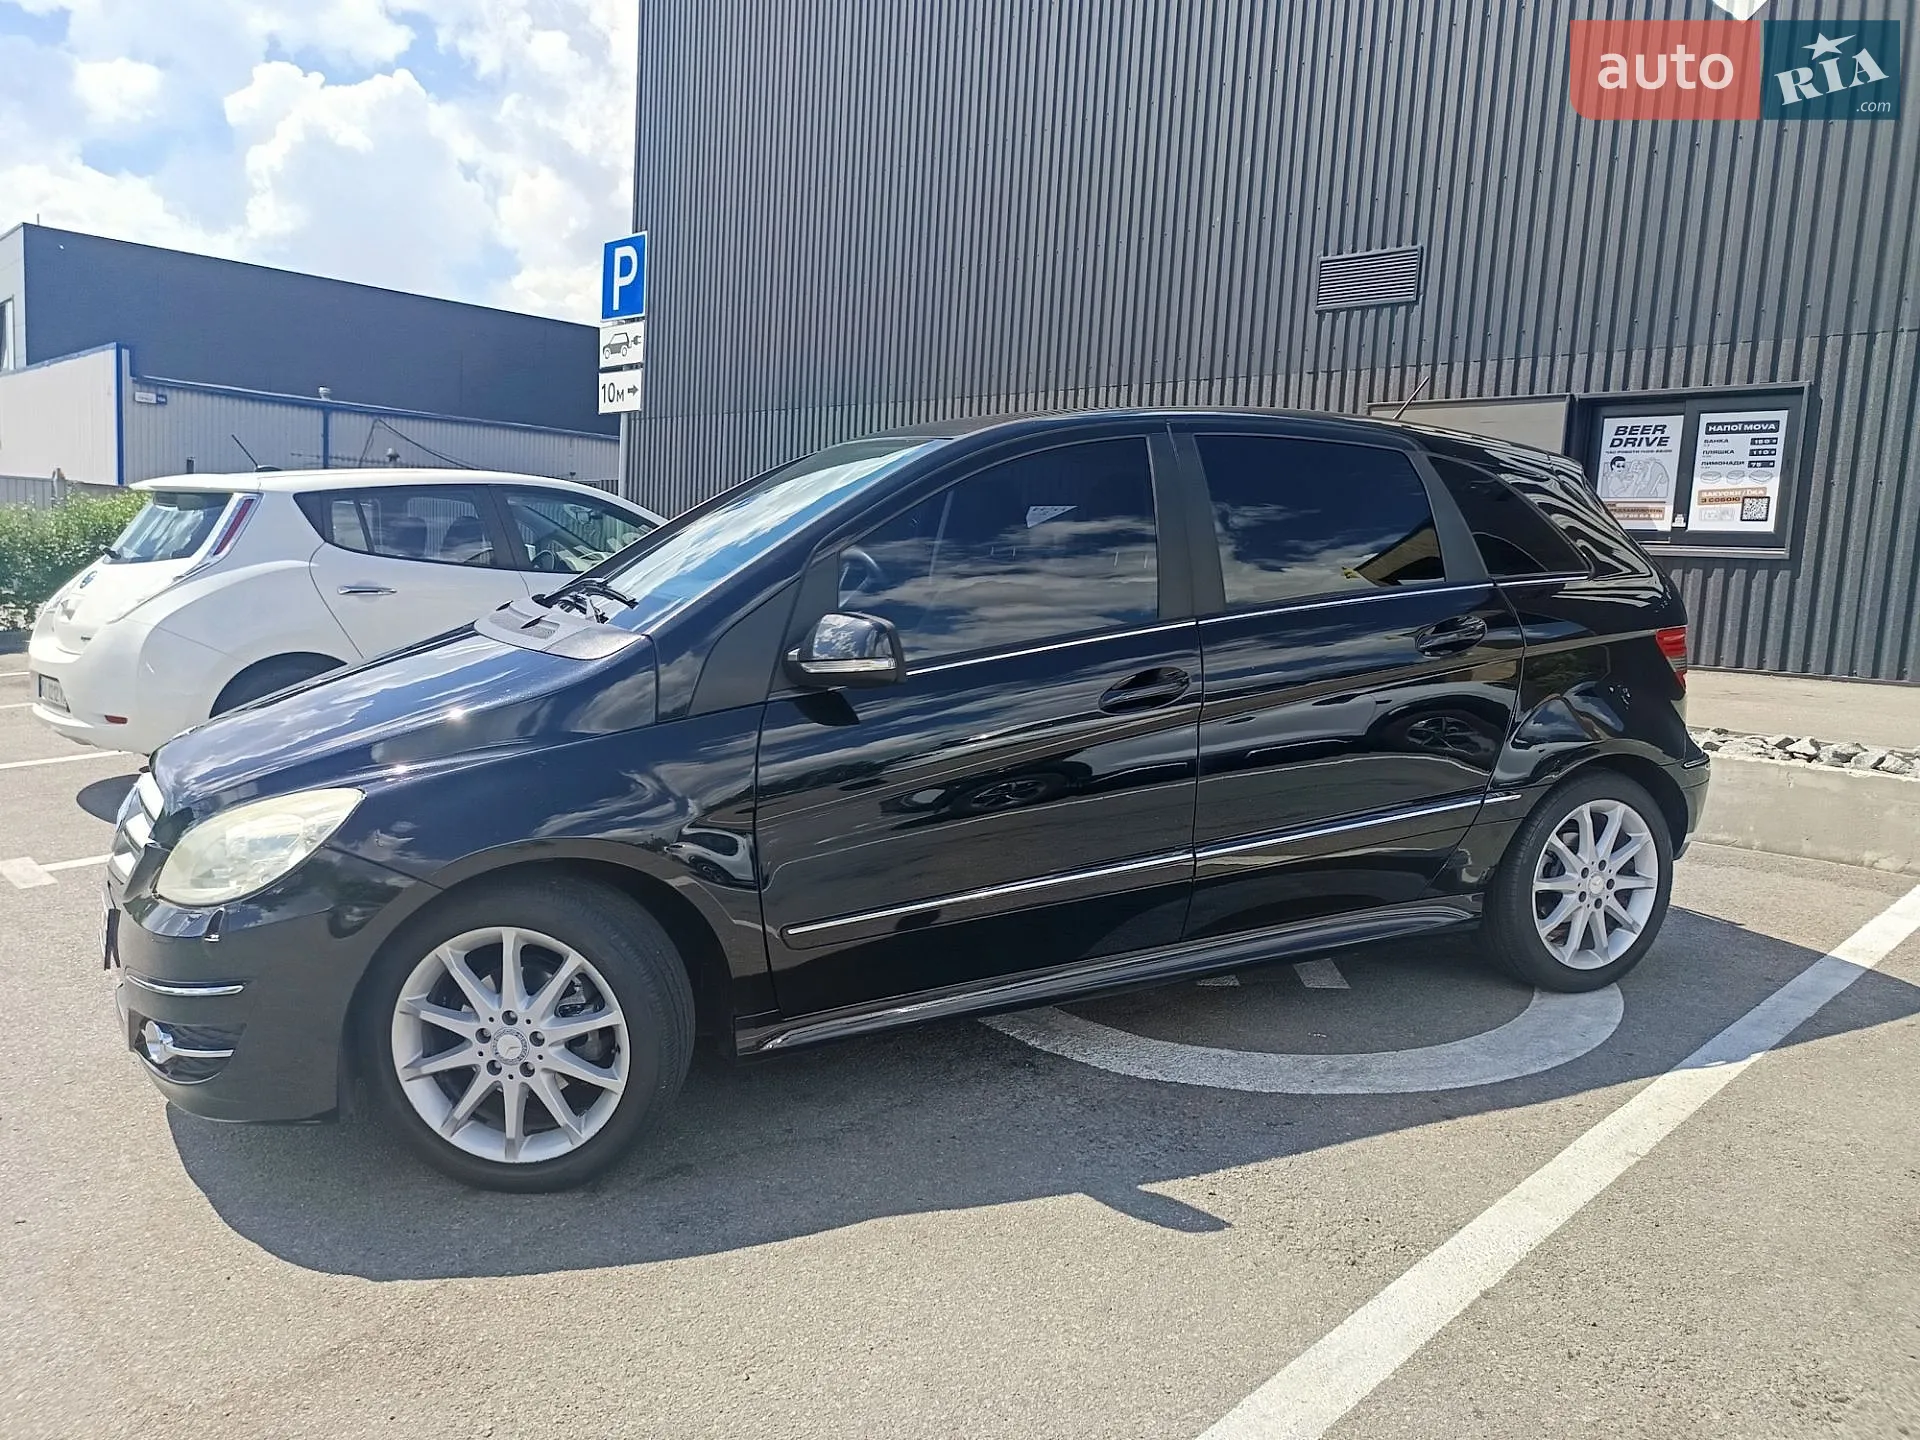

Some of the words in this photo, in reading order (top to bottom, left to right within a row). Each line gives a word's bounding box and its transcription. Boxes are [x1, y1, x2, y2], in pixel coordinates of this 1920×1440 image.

[612, 245, 638, 311] P
[1614, 424, 1667, 436] BEER
[1708, 423, 1743, 432] НАПОЇ
[1609, 436, 1670, 448] DRIVE
